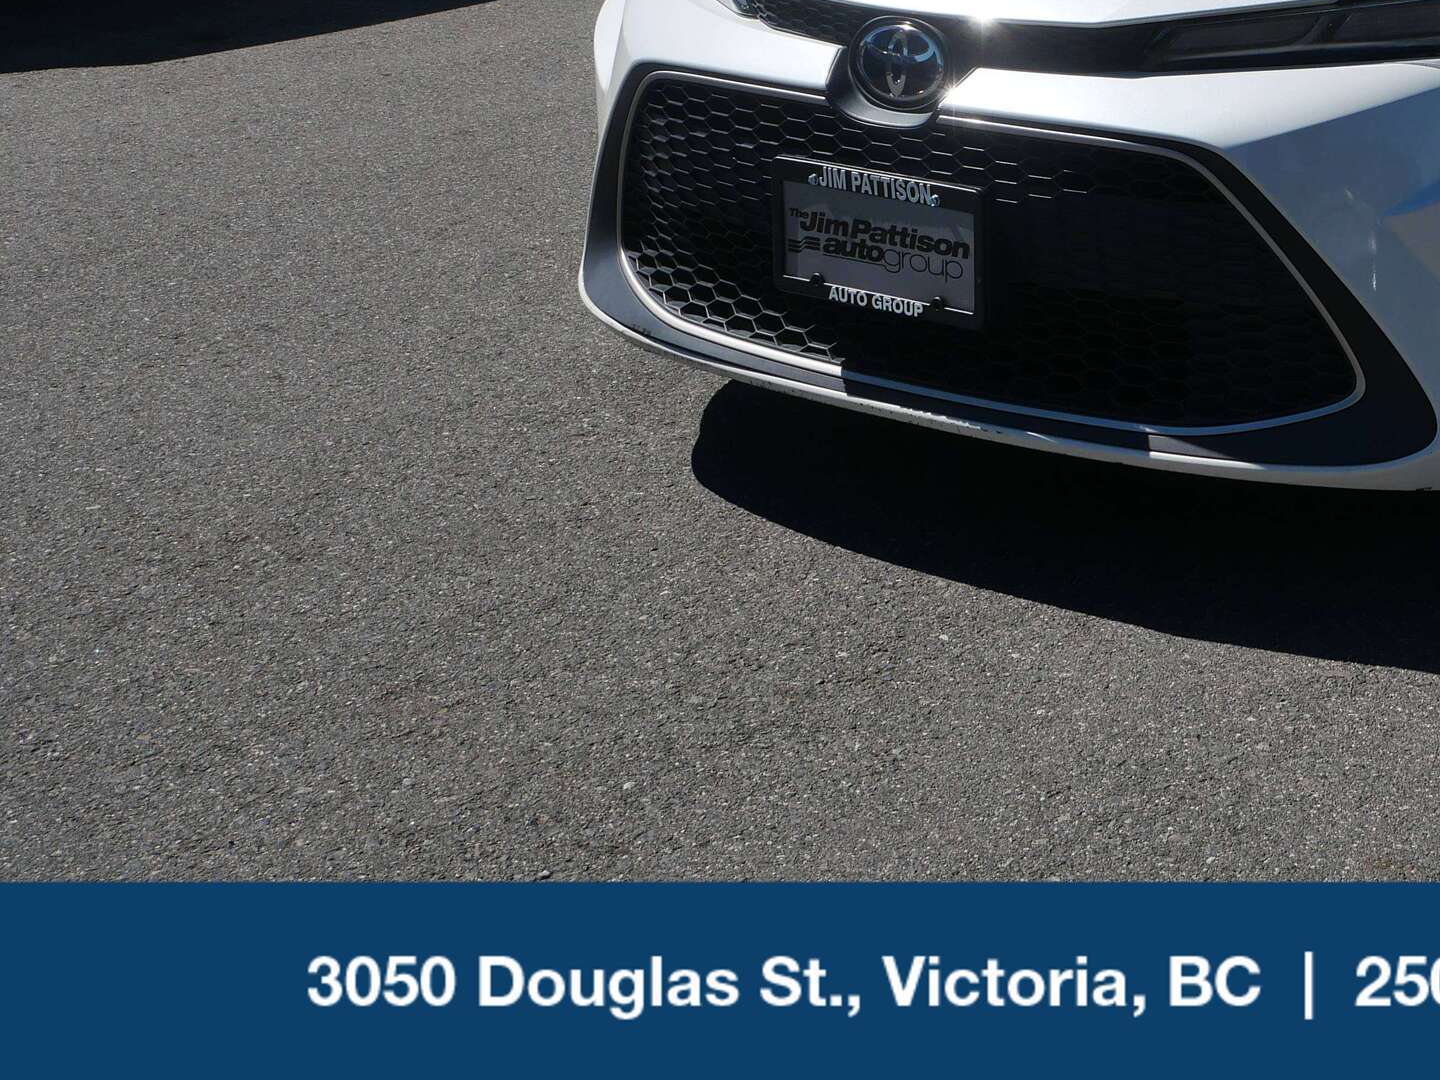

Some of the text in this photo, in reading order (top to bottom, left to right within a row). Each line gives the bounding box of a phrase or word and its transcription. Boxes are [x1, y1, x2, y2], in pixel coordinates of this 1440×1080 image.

[819, 166, 932, 206] JIM PATTISON
[789, 207, 809, 220] The
[829, 286, 924, 318] AUTO GROUP
